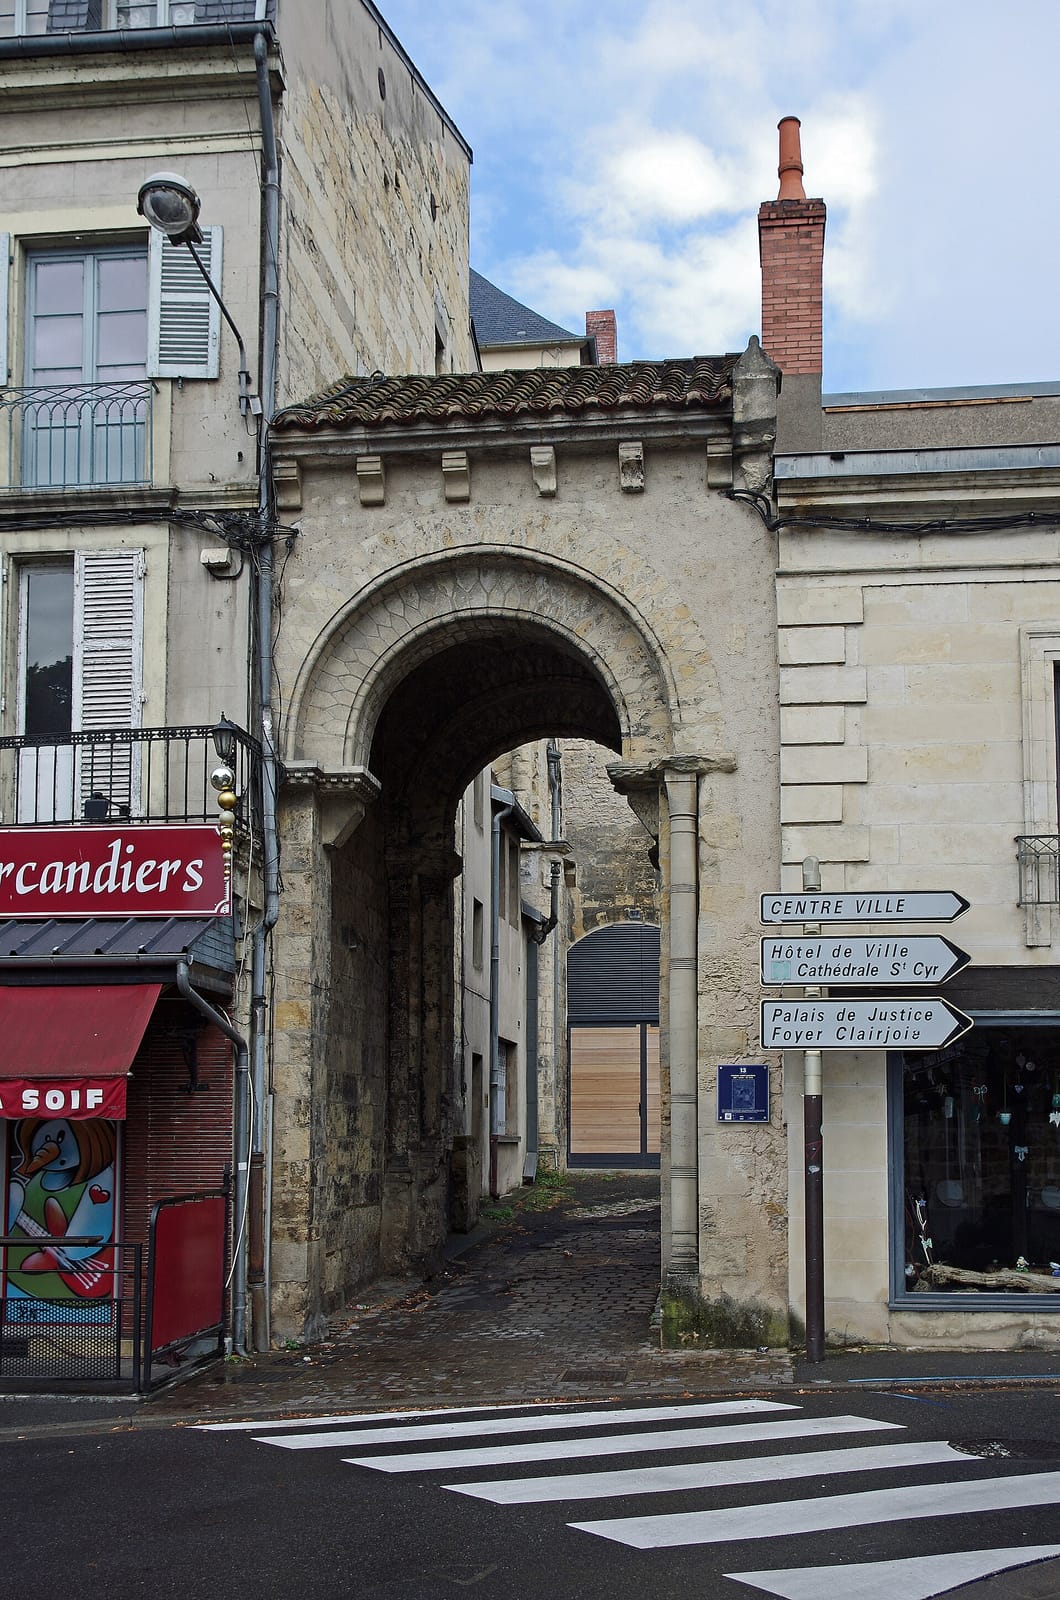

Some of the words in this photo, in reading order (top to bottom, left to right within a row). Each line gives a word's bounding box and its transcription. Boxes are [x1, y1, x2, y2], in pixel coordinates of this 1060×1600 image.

[770, 900, 844, 915] CENTRE
[856, 899, 906, 914] VILLE
[771, 944, 822, 959] Hôtel
[832, 944, 853, 958] de
[865, 943, 909, 958] Ville
[797, 962, 879, 977] Cathédrale
[890, 962, 908, 976] St
[913, 961, 939, 979] Cyr
[772, 1008, 825, 1022] Palais
[836, 1008, 856, 1022] de
[868, 1007, 933, 1022] Justice
[772, 1027, 823, 1043] Foyer
[836, 1026, 921, 1044] Clairjoie
[22, 1088, 104, 1110] SOIF
